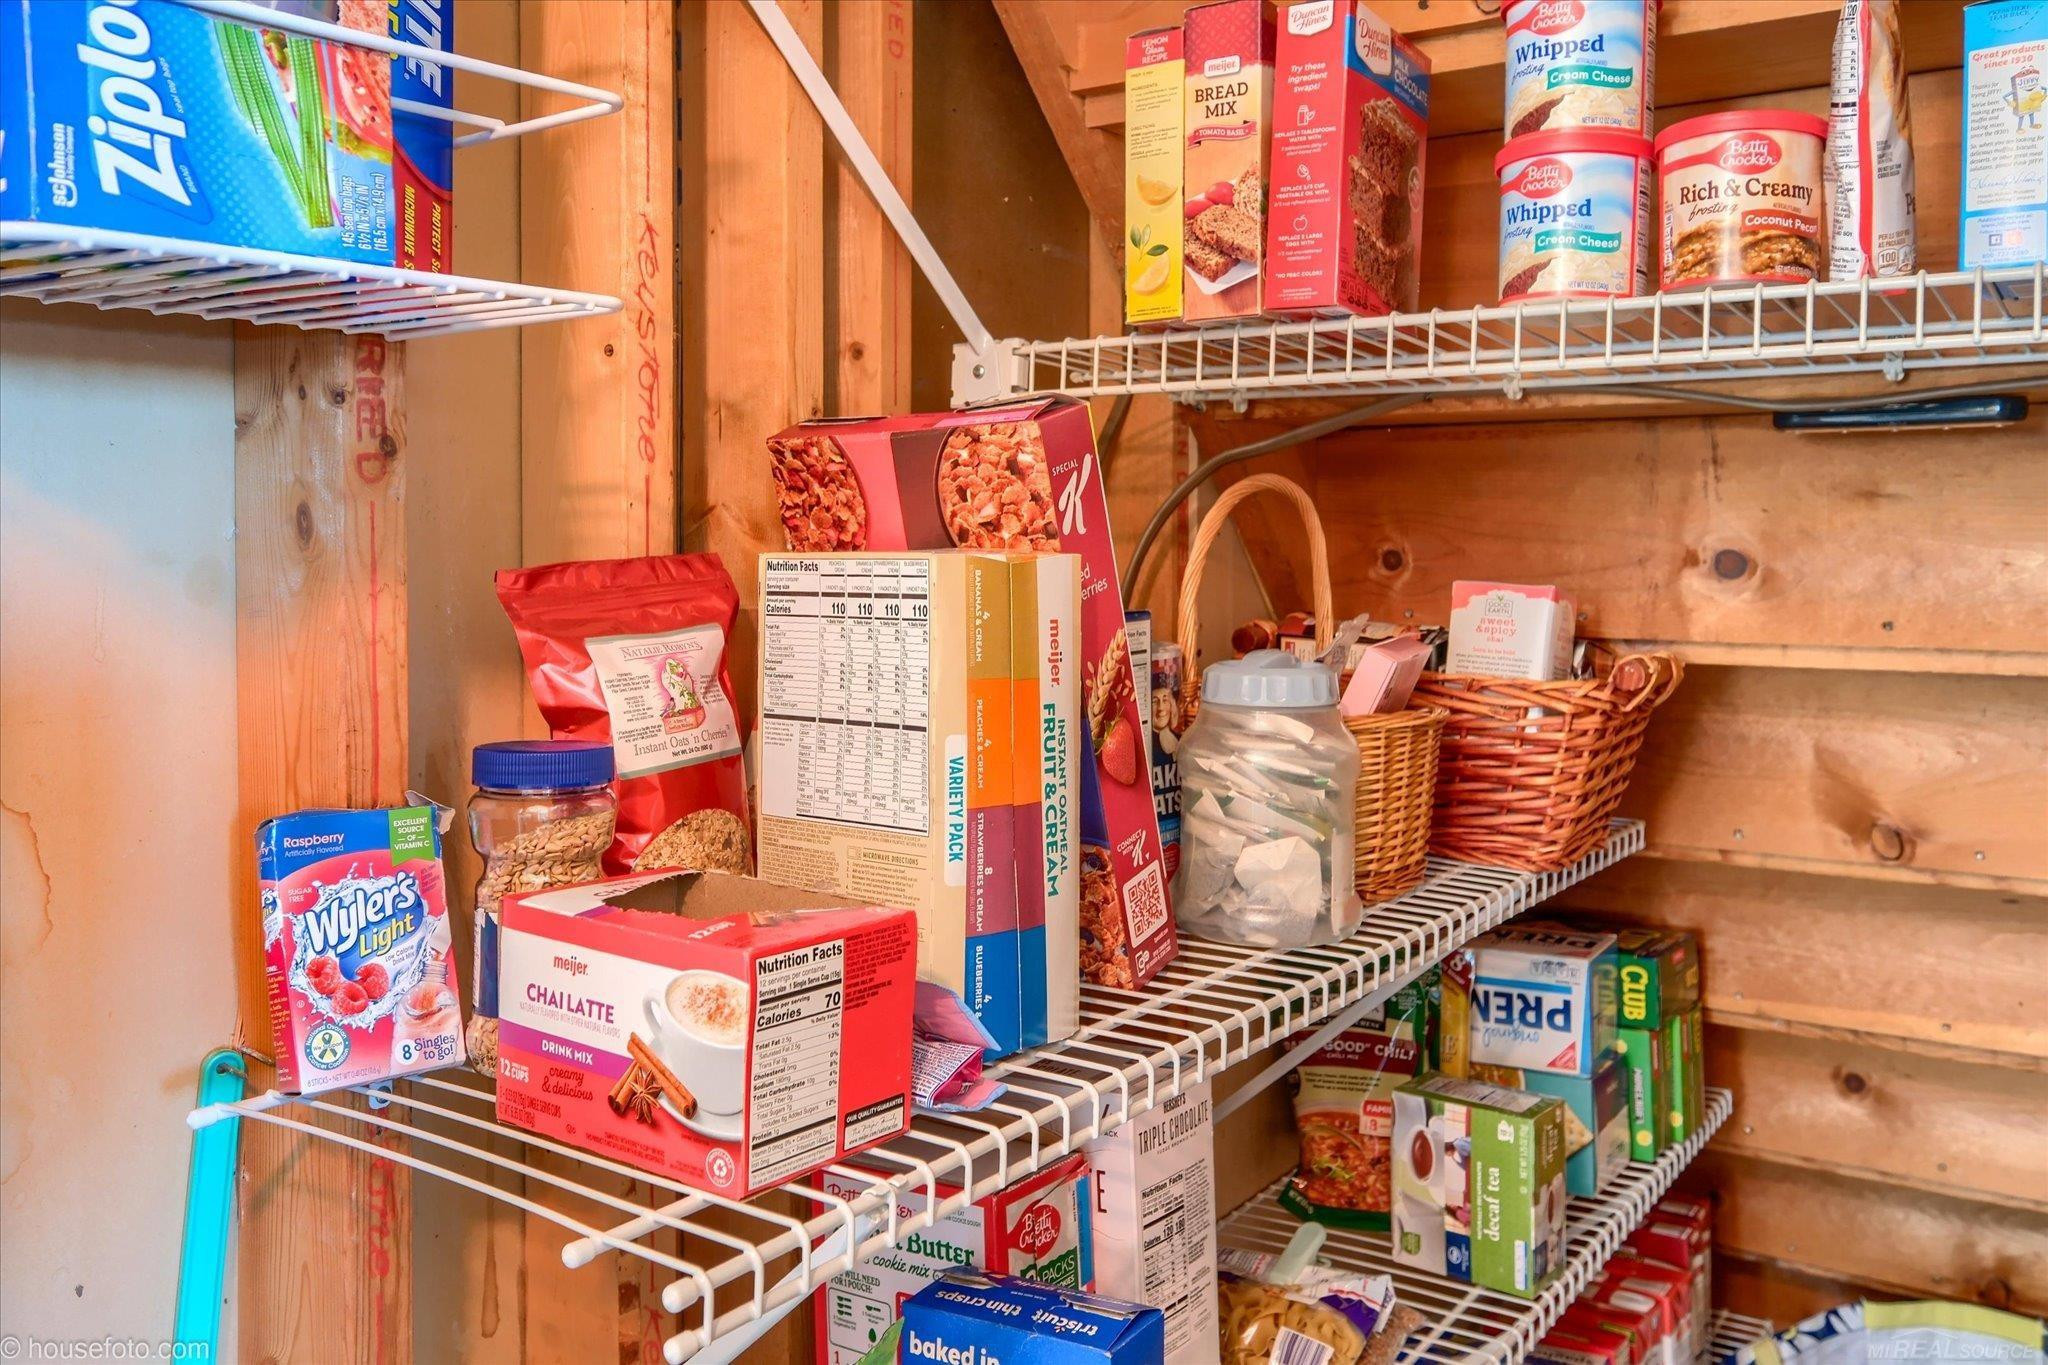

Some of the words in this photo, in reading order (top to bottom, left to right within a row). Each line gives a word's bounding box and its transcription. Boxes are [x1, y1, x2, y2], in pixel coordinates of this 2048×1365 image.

[1291, 4, 1330, 24] Duncan
[1539, 2, 1573, 17] Betty
[1532, 11, 1576, 31] Crocker
[1359, 17, 1390, 46] Duncan
[1141, 52, 1168, 64] RECIPE
[1516, 34, 1605, 64] Whipped
[1972, 50, 1999, 62] Great
[2002, 43, 2045, 57] products
[1207, 60, 1236, 75] meijer
[1394, 54, 1409, 75] MILK
[1984, 60, 2009, 69] since
[2011, 55, 2033, 64] 1930
[1511, 63, 1545, 85] frosting
[1550, 71, 1589, 83] Cream
[1592, 70, 1631, 83] Cheese
[1195, 82, 1249, 103] BREAD
[1394, 69, 1429, 107] CHOCOLATE
[76, 0, 192, 206] Ziplo
[1205, 101, 1237, 118] MIX
[1199, 129, 1226, 137] TOMATO
[1727, 139, 1768, 155] Betty
[1720, 152, 1776, 166] Crocker
[1527, 165, 1560, 180] Betty
[342, 176, 354, 198] bags
[1520, 176, 1565, 192] Crocker
[1680, 180, 1719, 205] Rich
[1724, 178, 1741, 196] &
[1745, 178, 1813, 205] Creamy
[343, 200, 355, 212] top
[1506, 199, 1592, 225] Whipped
[1689, 202, 1738, 222] frosting
[342, 213, 354, 231] seal
[404, 184, 415, 257] MICROWAVE
[431, 201, 442, 256] PROTECT
[1745, 215, 1793, 228] Coconut
[342, 233, 354, 249] 145
[1503, 225, 1533, 245] frosting
[1537, 234, 1575, 247] Cream
[1579, 235, 1619, 248] Cheese
[1881, 252, 1896, 263] 100
[1052, 459, 1079, 476] SPECIAL
[1058, 453, 1091, 536] K
[767, 561, 799, 573] Nutrition
[800, 561, 819, 573] Facts
[975, 569, 983, 617] BANANAS
[766, 604, 791, 614] Calories
[831, 602, 846, 615] 110
[858, 603, 872, 616] 110
[885, 604, 899, 617] 110
[913, 604, 928, 617] 110
[1480, 618, 1516, 626] sweet
[621, 647, 663, 659] NATALIE
[975, 628, 983, 662] CREAM
[1048, 619, 1063, 687] meijer
[634, 741, 667, 757] Instant
[670, 736, 689, 749] Oats
[1043, 703, 1056, 778] FRUIT
[1057, 719, 1066, 789] INSTANT
[976, 754, 984, 789] CREAM
[948, 756, 964, 818] VARIETY
[1045, 783, 1056, 801] &
[393, 817, 428, 827] EXCELLENT
[397, 825, 425, 833] SOURCE
[284, 833, 345, 848] Raspberry
[948, 823, 964, 863] PACK
[1059, 796, 1068, 875] OATMEAL
[1117, 829, 1142, 852] CONNECT
[285, 848, 316, 858] Artificially
[316, 845, 344, 855] Flavored
[395, 842, 420, 850] VITAMIN
[1045, 803, 1059, 897] CREAM
[863, 853, 890, 862] MICROWAVE
[891, 857, 919, 866] DIRECTIONS
[984, 867, 993, 876] 8
[288, 887, 312, 895] SUGAR
[304, 872, 416, 955] Wyler's
[976, 898, 984, 932] CREAM
[359, 913, 416, 957] Light
[553, 955, 588, 977] meijer
[758, 952, 809, 975] Nutrition
[812, 943, 843, 961] Facts
[975, 945, 983, 1012] BLUEBERRIES
[759, 988, 777, 998] Serving
[1621, 965, 1649, 1021] CLUB
[527, 983, 563, 1010] CHAI
[567, 993, 614, 1024] LATTE
[757, 1008, 802, 1027] Calories
[825, 991, 841, 1009] 70
[306, 1023, 326, 1046] National
[327, 1023, 346, 1039] Ovarian
[402, 1044, 412, 1060] 8
[424, 1049, 436, 1060] to
[437, 1044, 454, 1060] go!
[414, 1033, 455, 1051] Singles
[308, 1055, 327, 1070] Cancer
[541, 1039, 572, 1059] DRINK
[574, 1049, 593, 1066] MIX
[500, 1058, 510, 1077] 12
[511, 1067, 529, 1083] CUPS
[550, 1067, 584, 1086] creamy
[753, 1066, 785, 1081] Cholesterol
[542, 1076, 552, 1093] &
[552, 1081, 593, 1101] delicious
[753, 1081, 774, 1092] Sodium
[858, 1107, 877, 1120] QUALITY
[1139, 1121, 1167, 1155] TRIPLE
[1169, 1099, 1208, 1141] CHOCOLATE
[1142, 1182, 1167, 1198] Nutrition
[1168, 1173, 1183, 1186] Facts
[1487, 1167, 1500, 1191] tea
[1483, 1194, 1500, 1242] decaf
[906, 1232, 974, 1267] Butter
[872, 1254, 906, 1273] cookie
[908, 1264, 930, 1278] mix
[1042, 1255, 1075, 1283] PACKS
[862, 1274, 880, 1287] NEED
[935, 1290, 986, 1308] crisps
[987, 1299, 1022, 1316] thin
[1031, 1308, 1099, 1337] triscuit
[909, 1331, 977, 1365] baked
